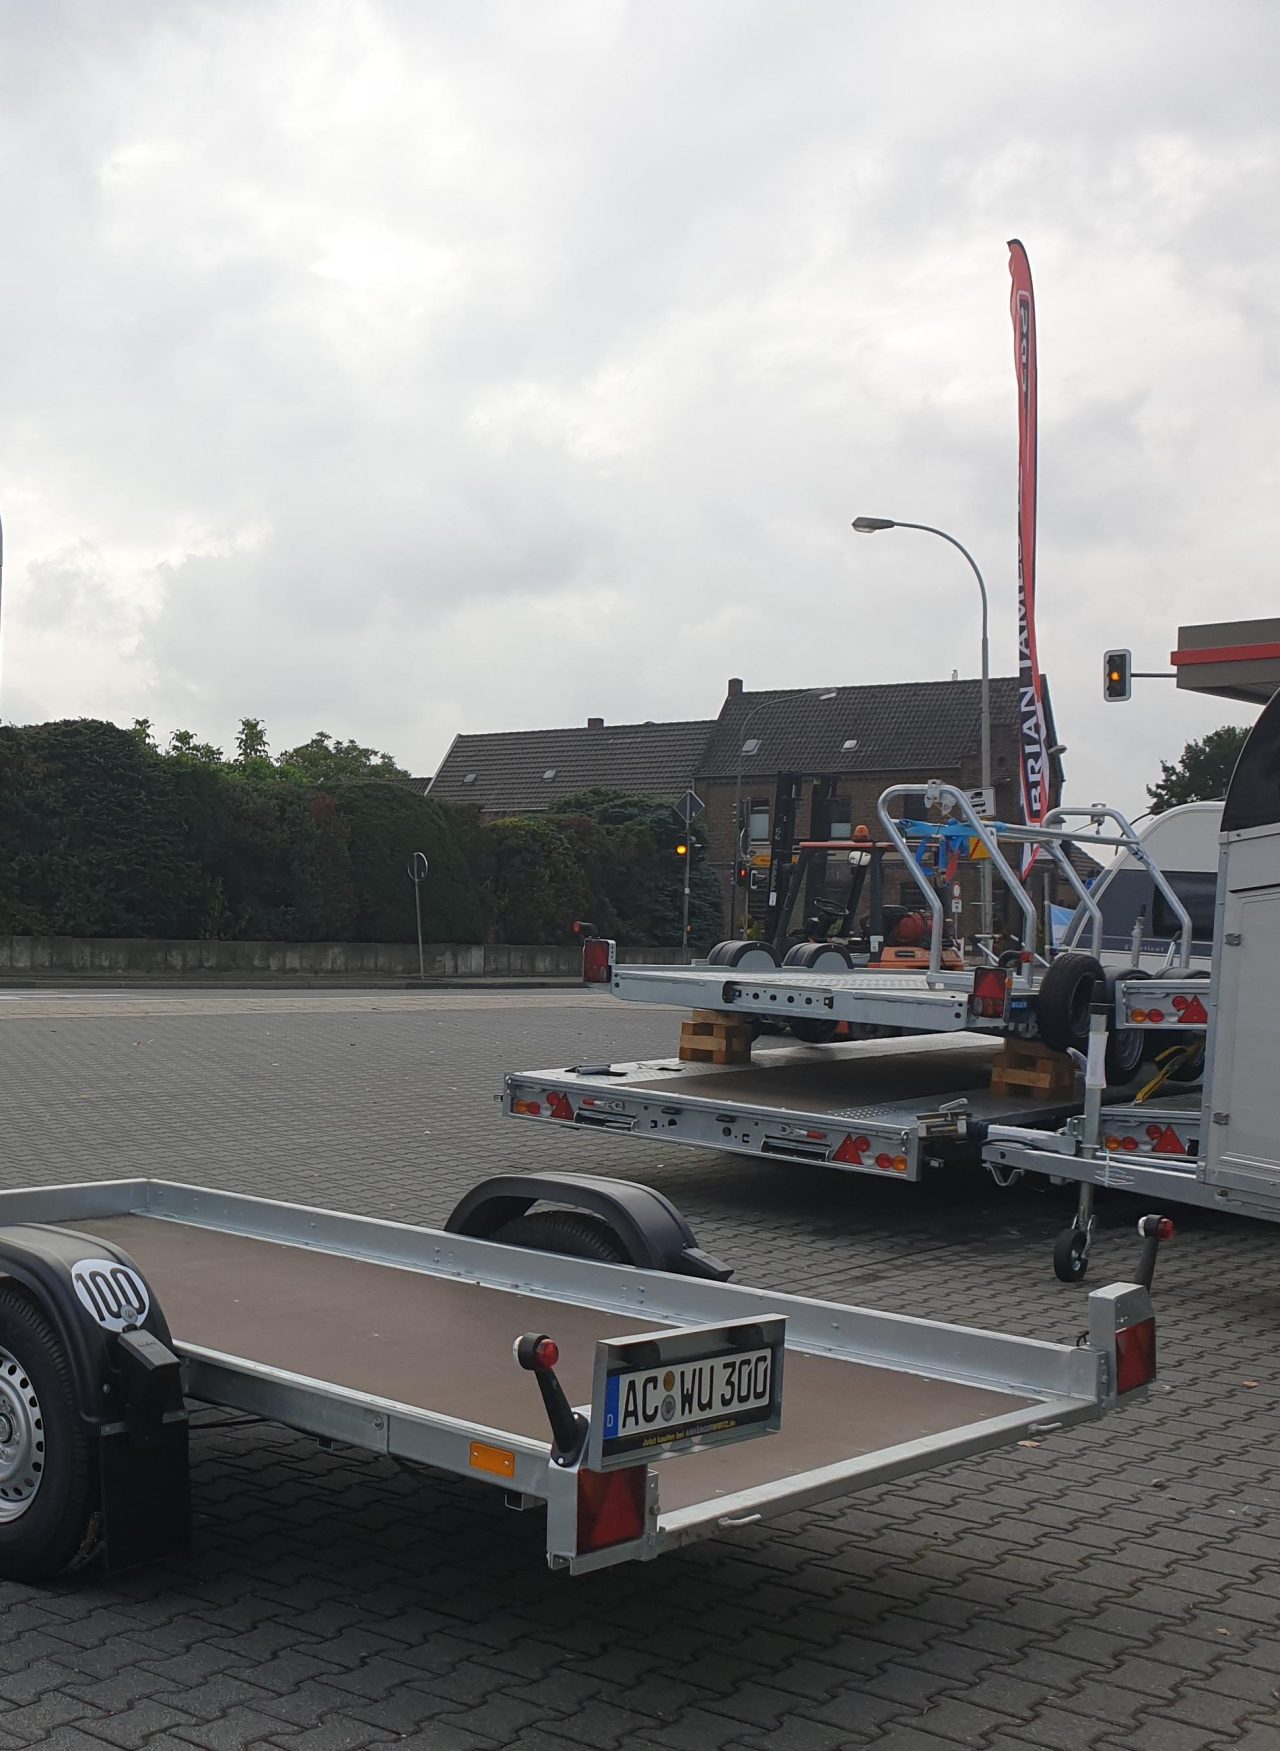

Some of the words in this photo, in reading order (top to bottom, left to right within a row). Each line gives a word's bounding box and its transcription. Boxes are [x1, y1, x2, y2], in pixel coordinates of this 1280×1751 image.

[1020, 687, 1042, 812] BRIAN
[74, 1268, 146, 1321] 100
[606, 1414, 613, 1428] D
[622, 1375, 658, 1429] AC
[680, 1365, 714, 1416] WU
[721, 1355, 768, 1407] 300
